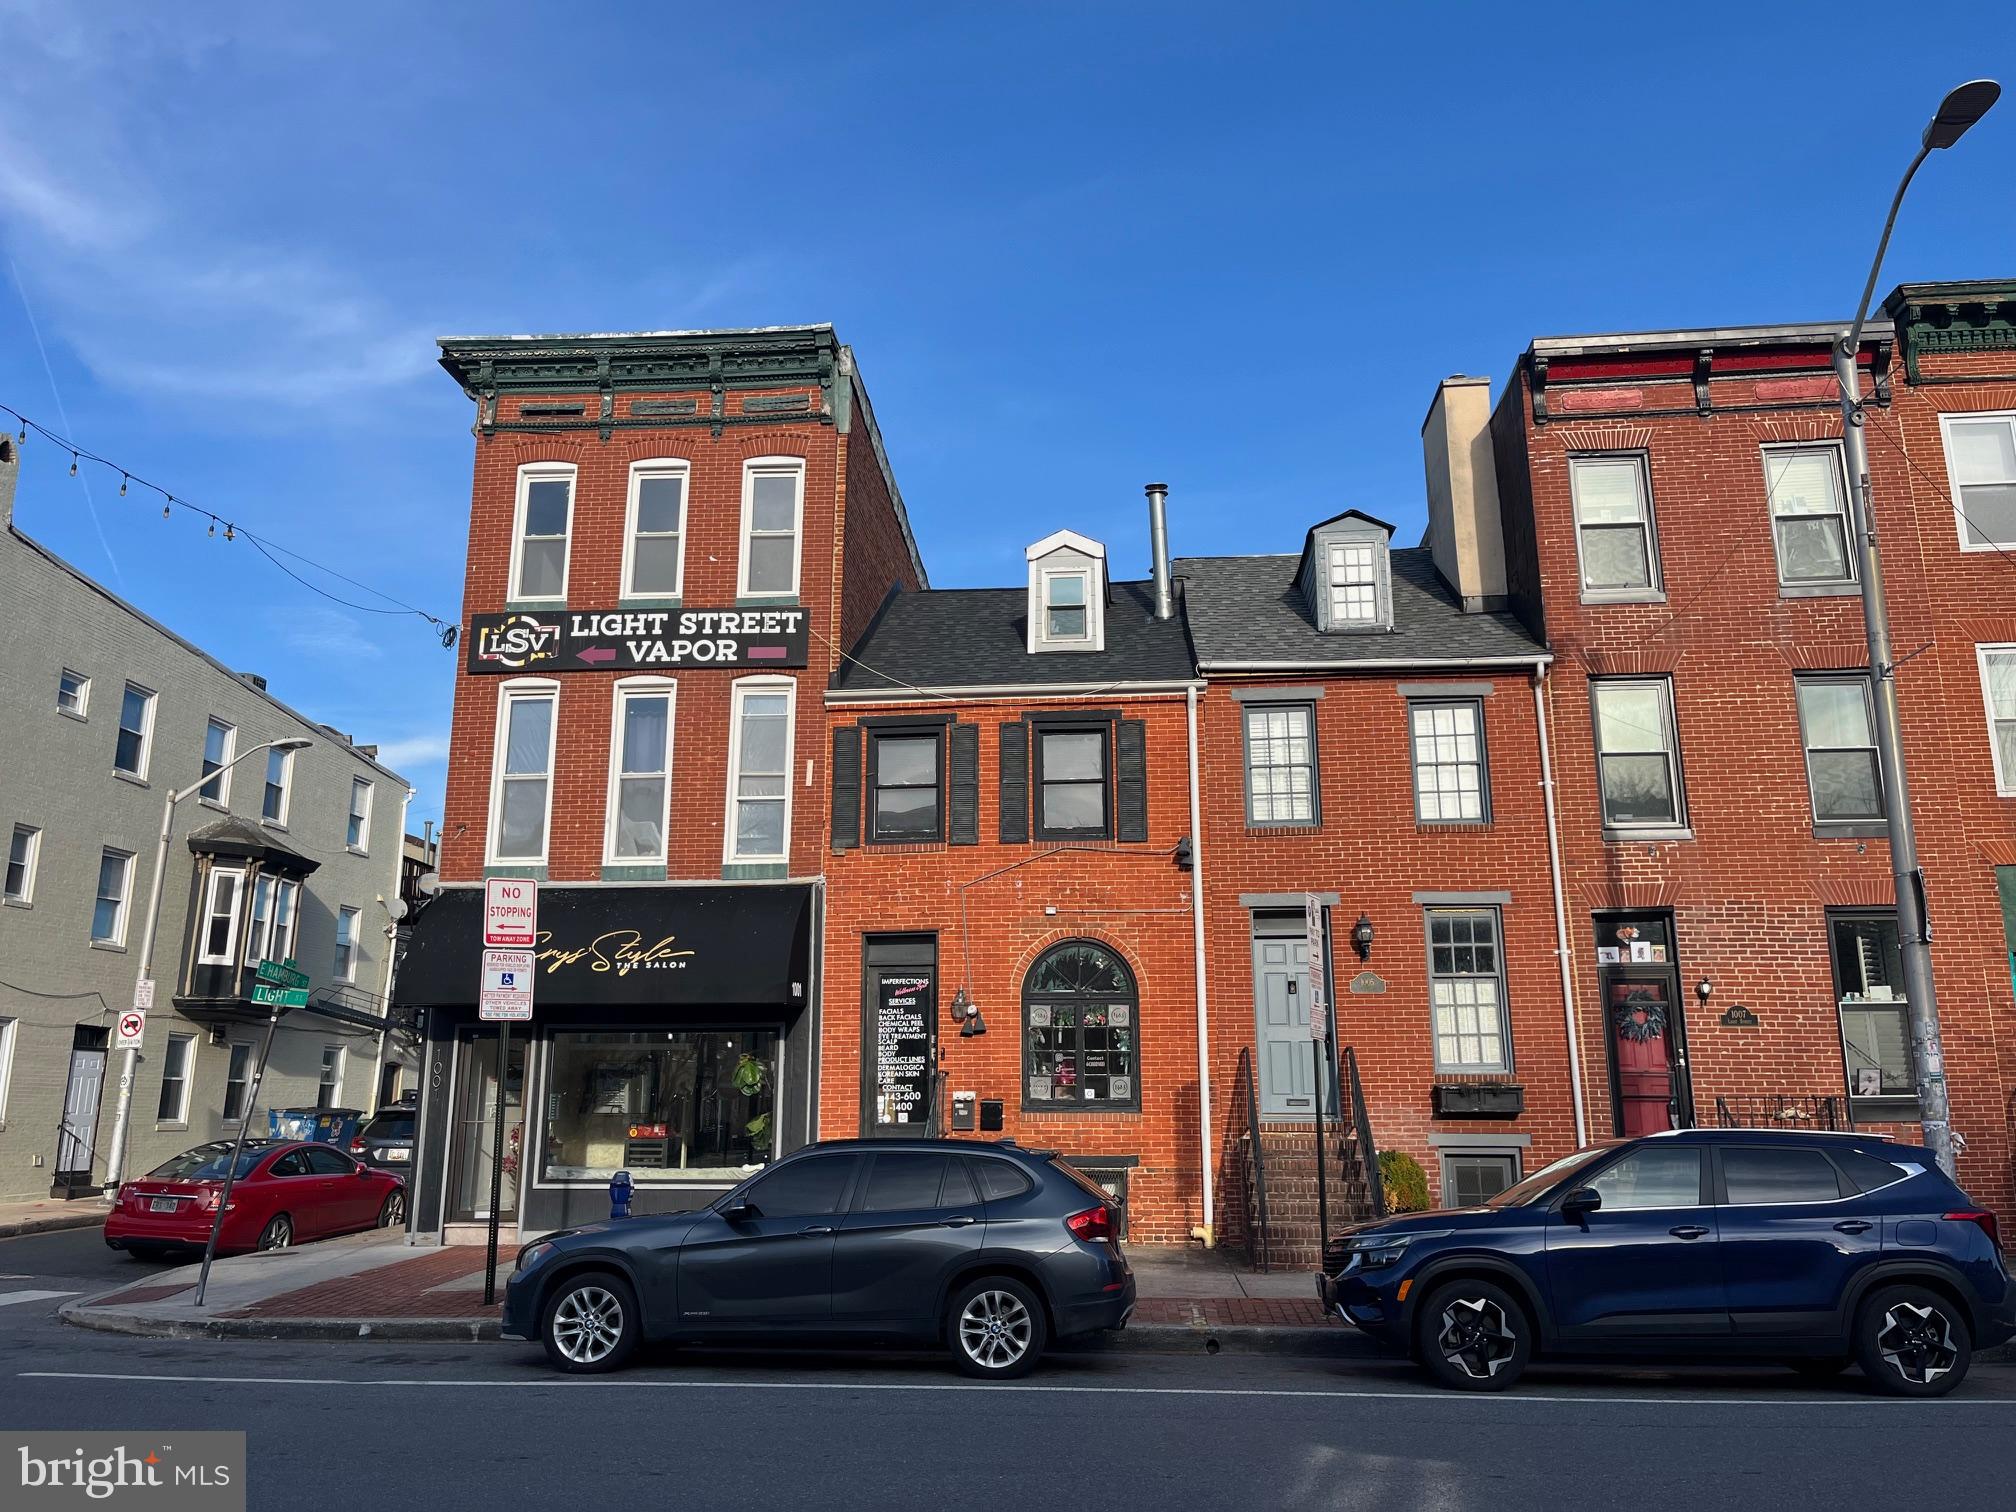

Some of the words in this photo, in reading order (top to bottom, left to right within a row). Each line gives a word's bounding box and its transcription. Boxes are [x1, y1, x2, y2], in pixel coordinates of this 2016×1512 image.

[569, 612, 669, 637] LIGHT
[678, 611, 803, 635] STREET
[489, 627, 549, 654] LSV
[626, 639, 738, 663] VAPOR
[502, 887, 521, 899] NO
[490, 906, 532, 918] STOPPING
[592, 930, 695, 976] Style
[491, 954, 527, 963] PARKING
[616, 962, 638, 970] THE
[645, 961, 687, 969] SALON
[260, 962, 267, 975] E
[267, 965, 300, 987] HAMBURG
[257, 988, 291, 1002] LIGHT
[888, 997, 916, 1005] SERVICES
[1731, 1010, 1746, 1018] 1007
[878, 1056, 908, 1064] PRODUCT
[882, 1084, 914, 1092] CONTACT
[885, 1092, 921, 1101] 443-600
[889, 1102, 913, 1111] -1400
